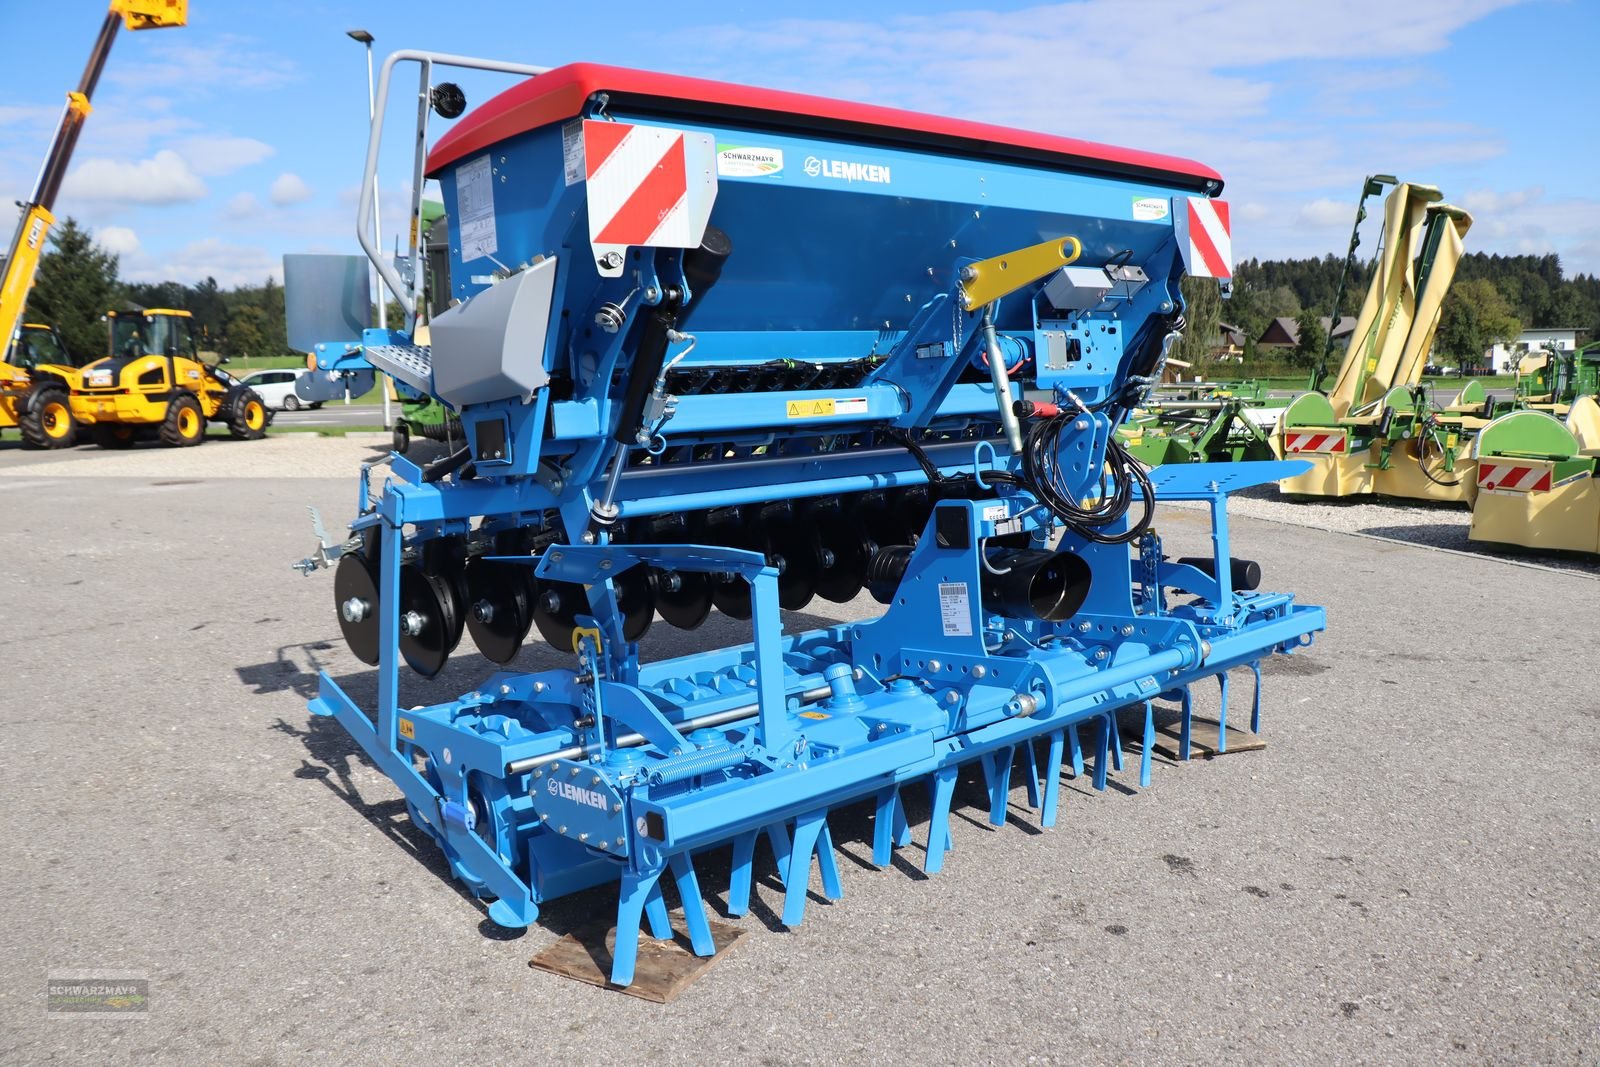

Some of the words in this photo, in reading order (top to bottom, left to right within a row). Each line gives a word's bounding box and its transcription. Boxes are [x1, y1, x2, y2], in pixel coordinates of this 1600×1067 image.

[723, 152, 774, 162] SCHWARZMAYR
[821, 159, 891, 184] LEMKEN
[559, 781, 608, 811] LEMKEN
